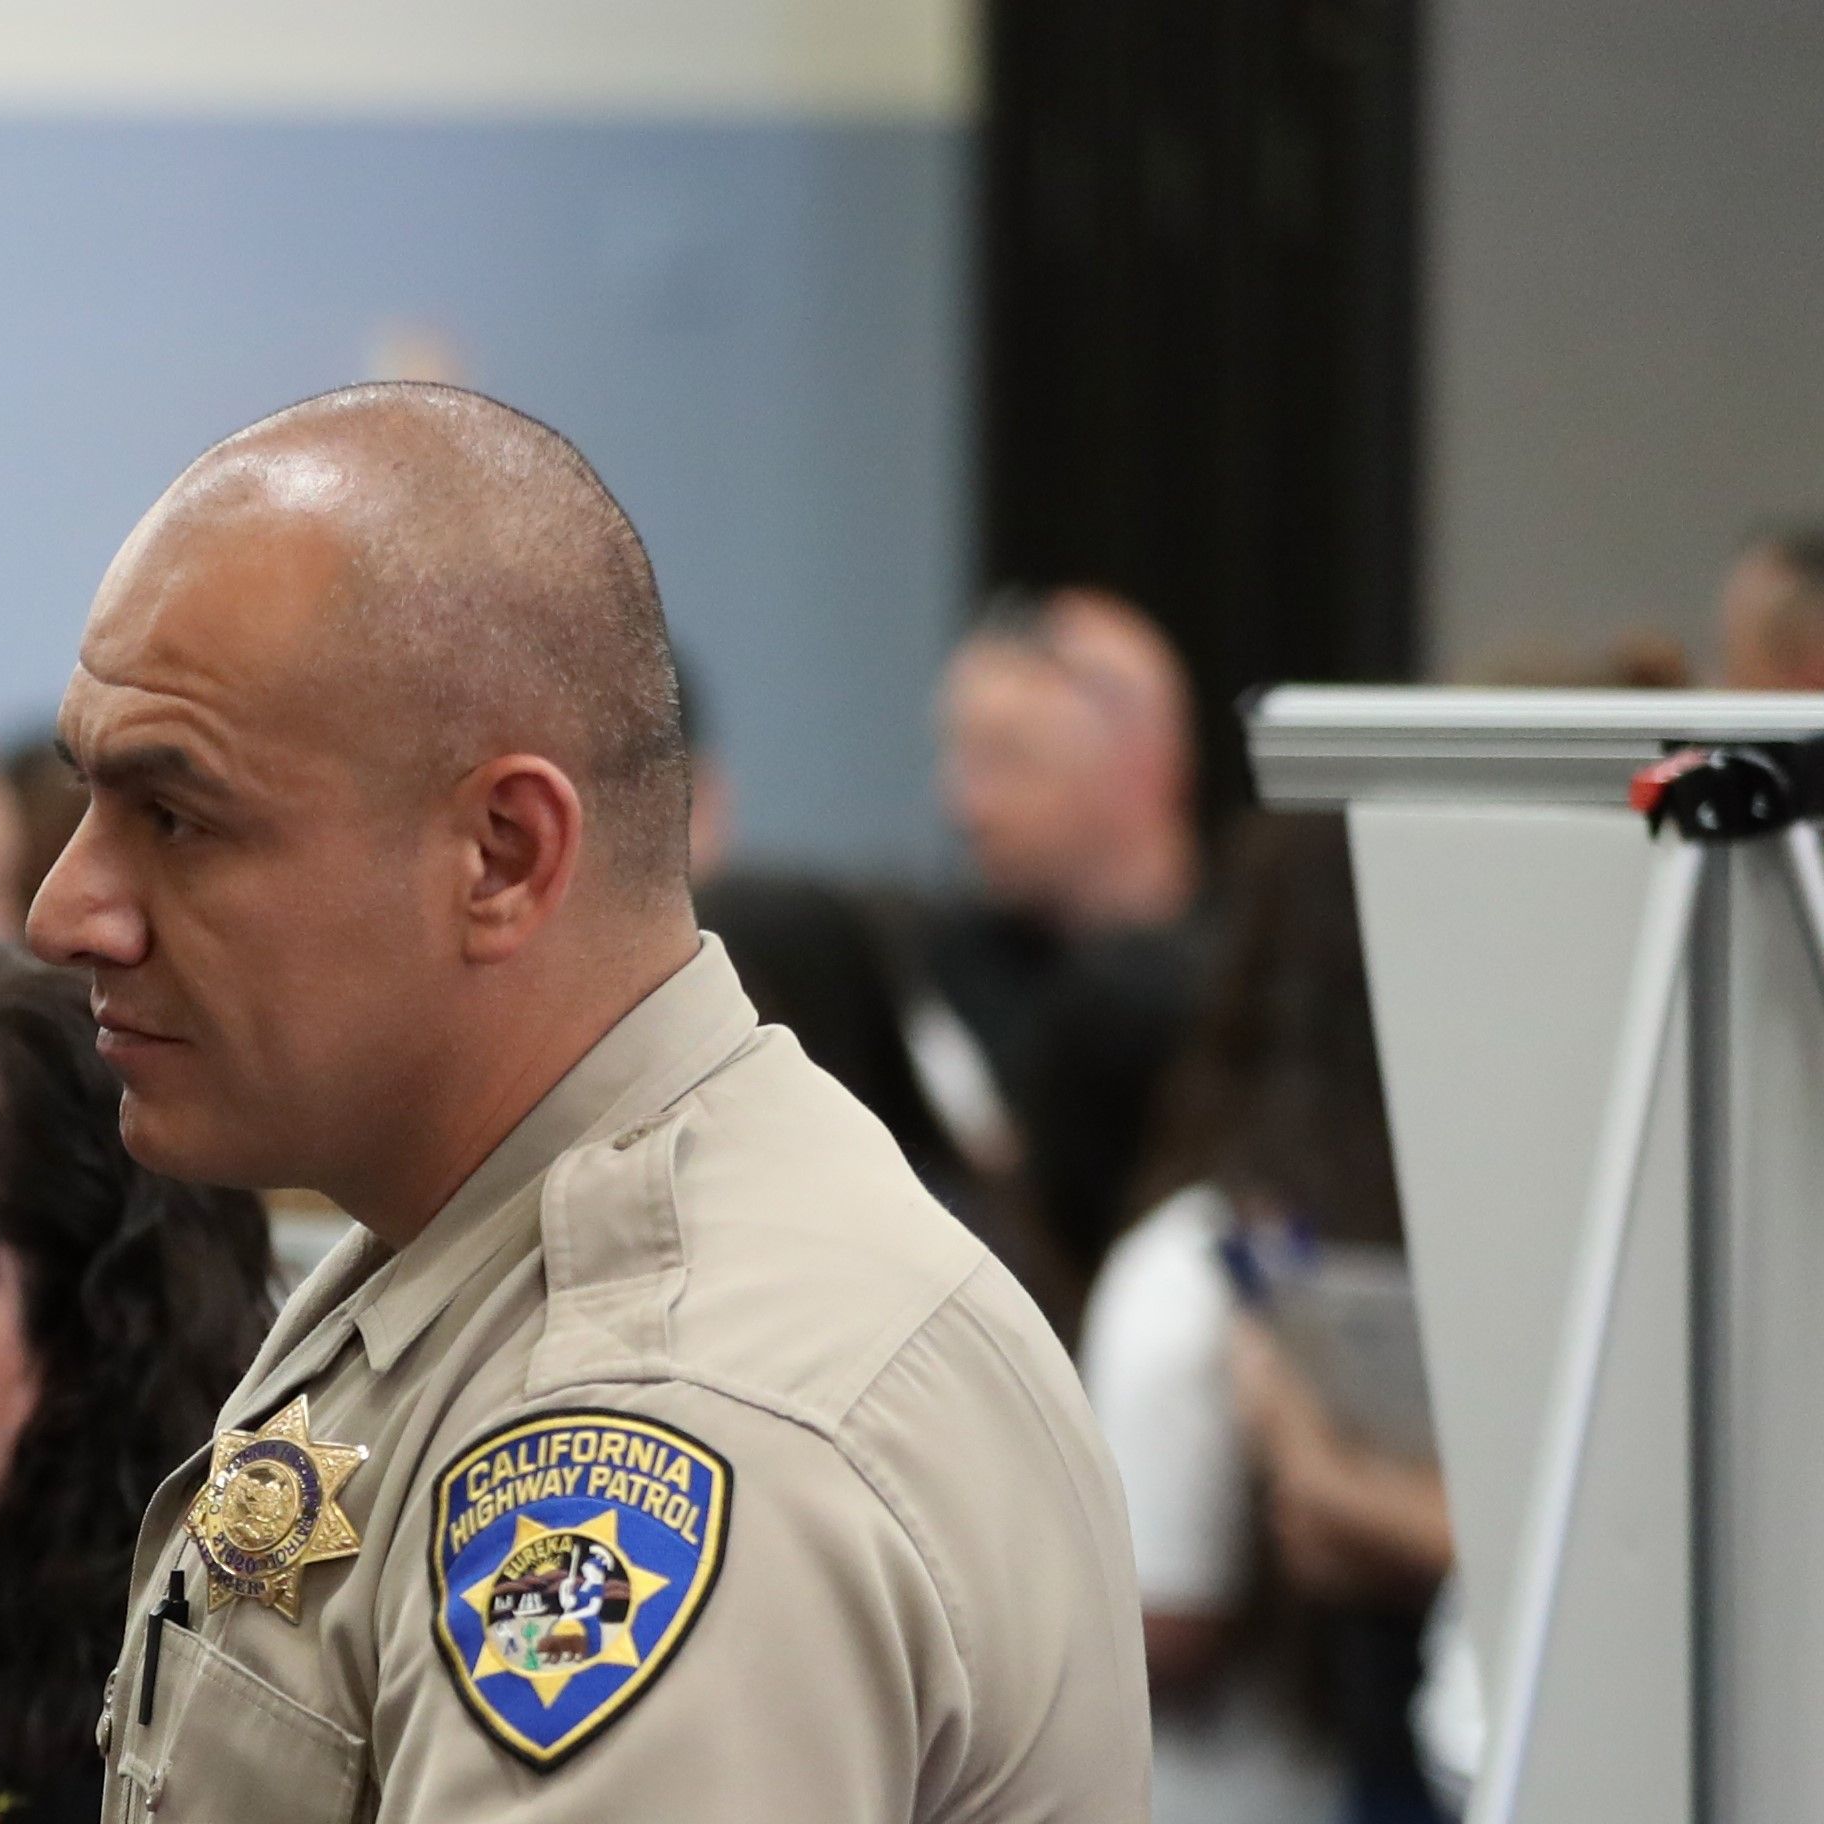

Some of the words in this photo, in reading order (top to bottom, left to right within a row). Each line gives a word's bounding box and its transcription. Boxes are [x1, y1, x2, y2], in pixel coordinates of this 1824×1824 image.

[466, 1430, 692, 1502] CALIFORNIA
[449, 1465, 583, 1554] HIGHWAY
[587, 1465, 699, 1546] PATROL
[503, 1535, 575, 1580] EUREKA
